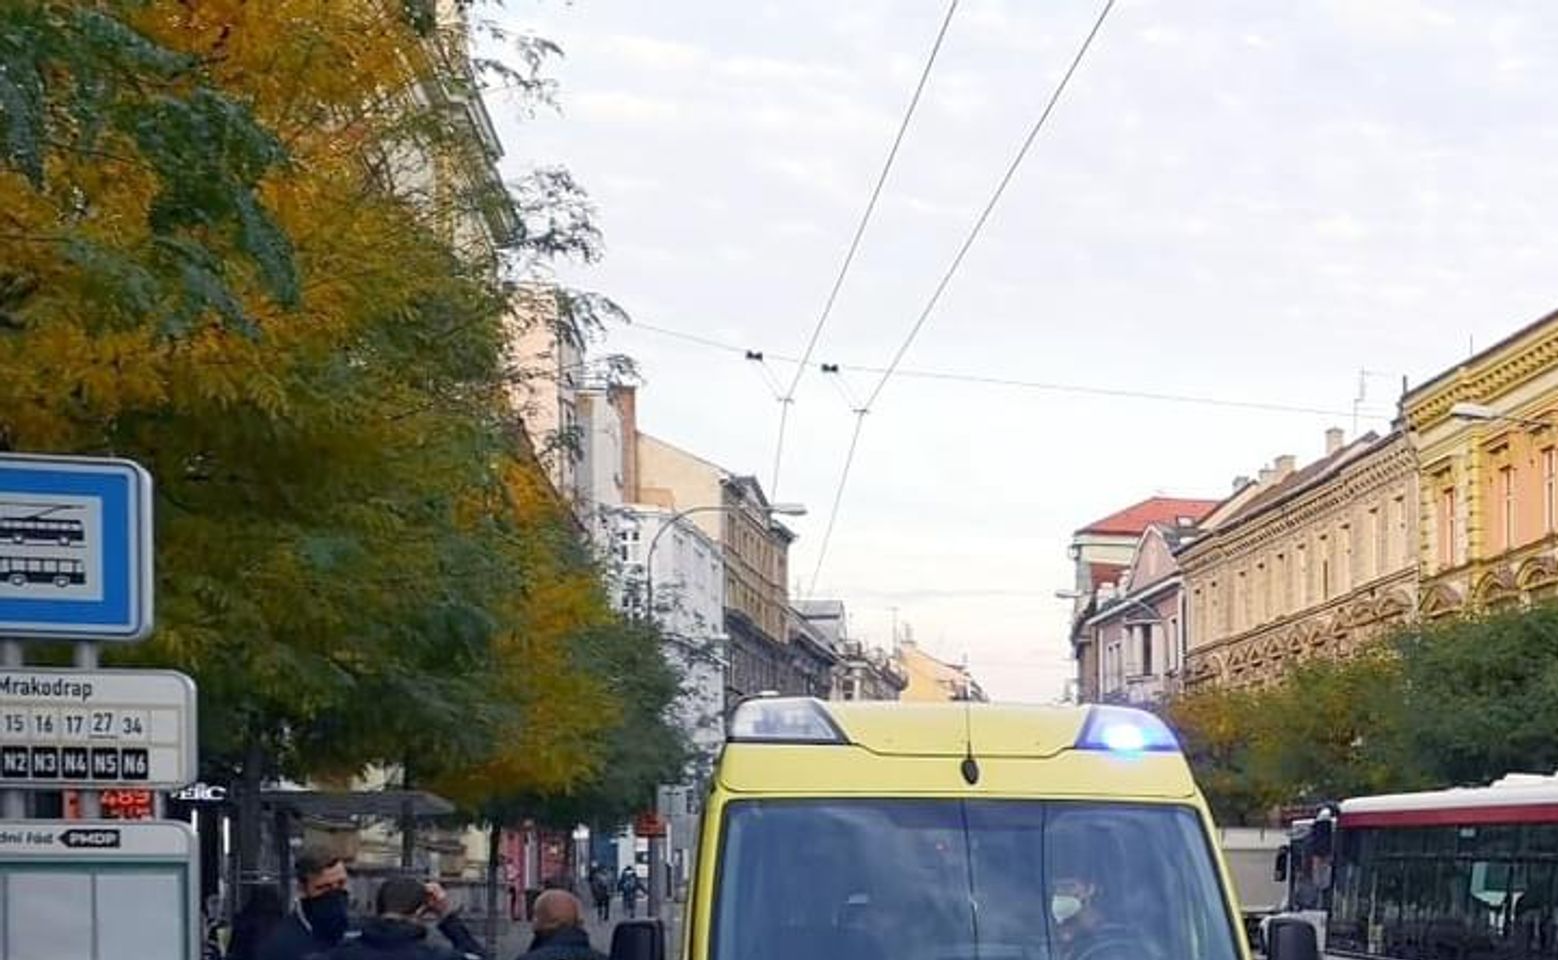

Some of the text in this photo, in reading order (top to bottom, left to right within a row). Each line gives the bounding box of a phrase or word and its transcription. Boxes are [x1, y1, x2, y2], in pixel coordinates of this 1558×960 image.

[0, 676, 92, 701] Mrakodrap
[5, 713, 142, 734] 15 16 17 27 34
[4, 753, 146, 774] N2 N3 N4 N5 N6
